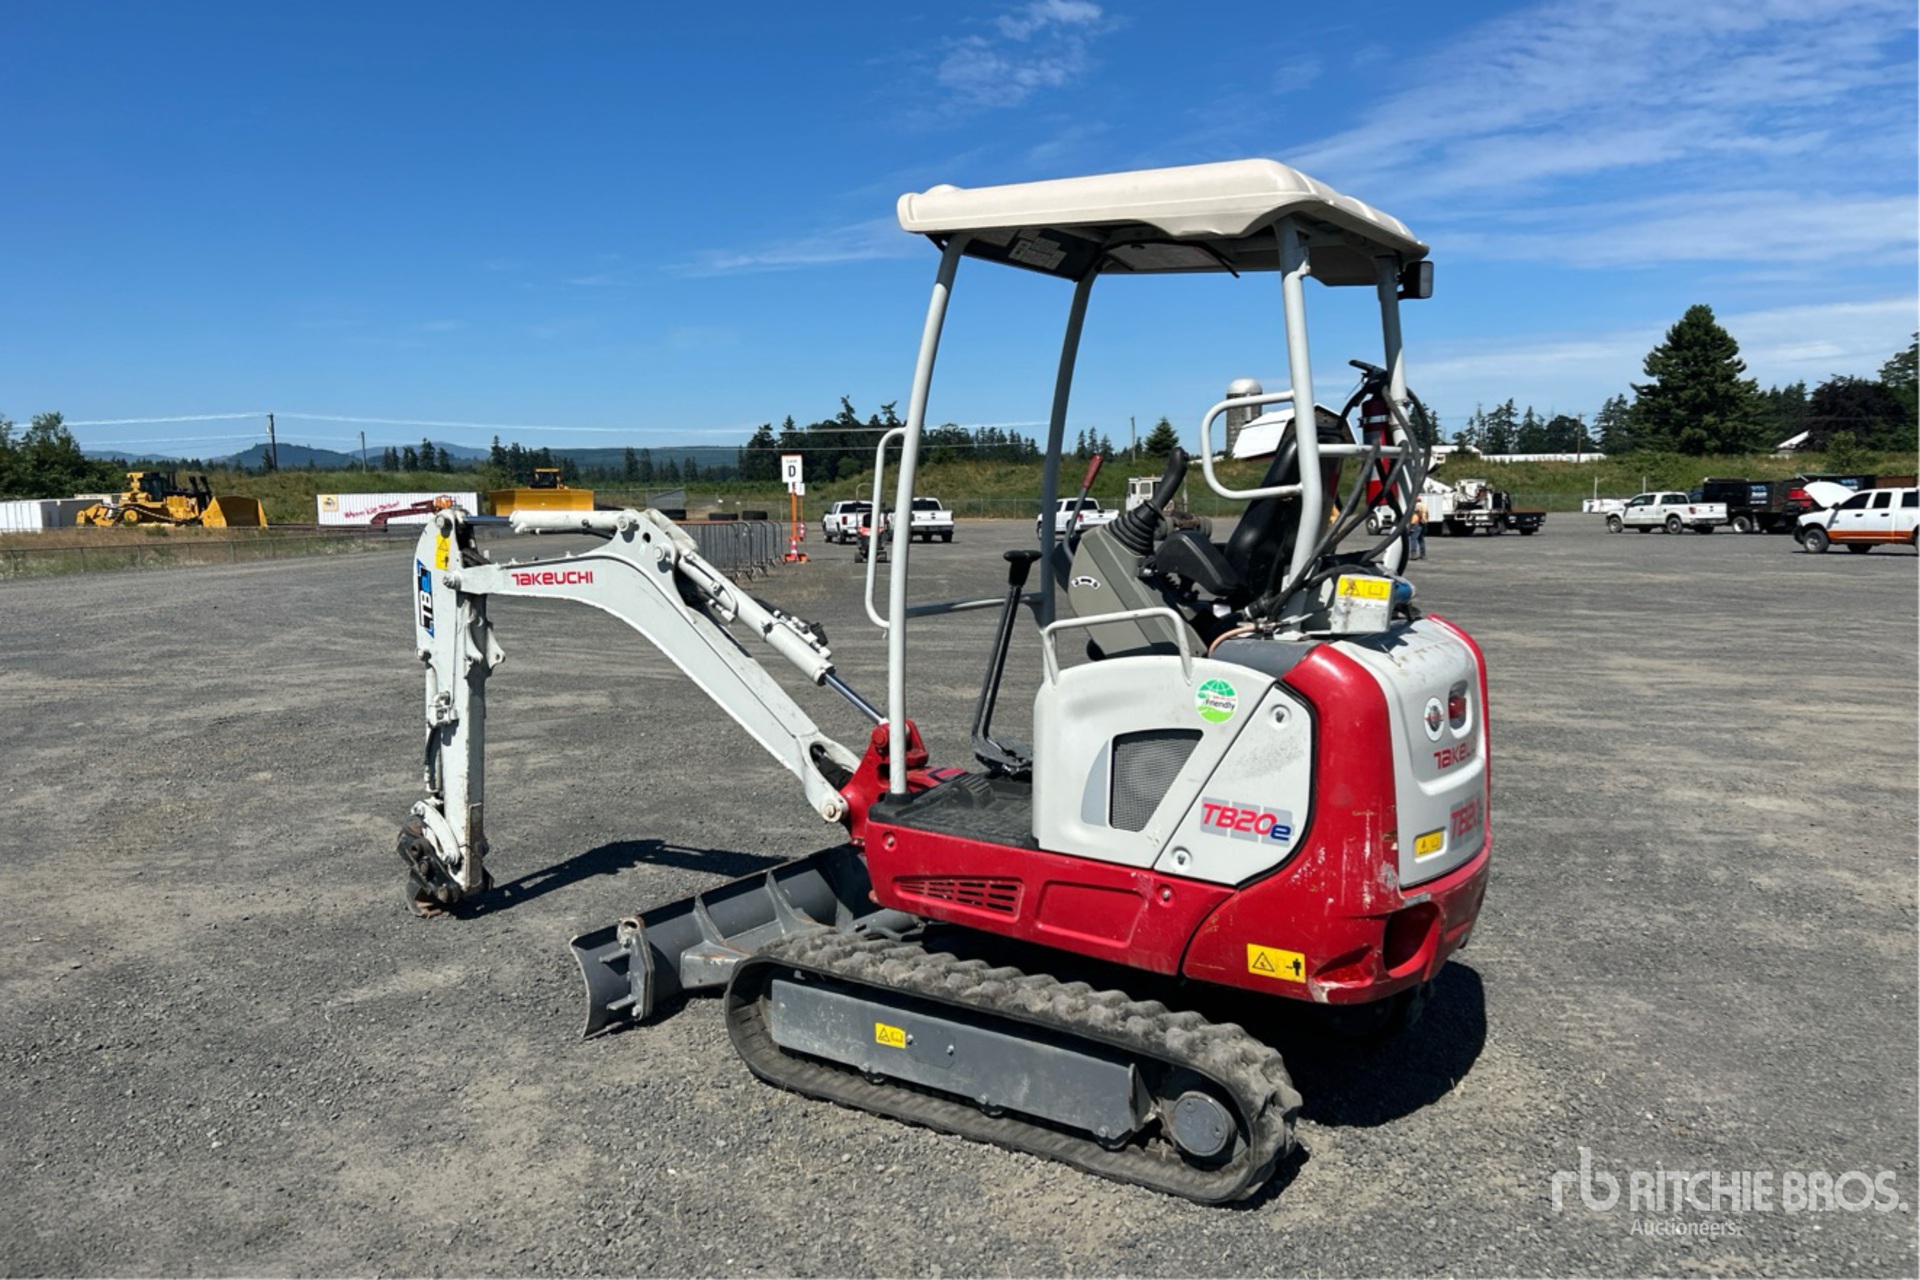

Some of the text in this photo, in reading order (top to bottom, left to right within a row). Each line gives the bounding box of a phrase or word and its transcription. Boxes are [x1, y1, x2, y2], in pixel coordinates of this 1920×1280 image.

[788, 465, 796, 478] D
[511, 571, 594, 586] TAKEUCHI
[1203, 803, 1292, 842] TB20e
